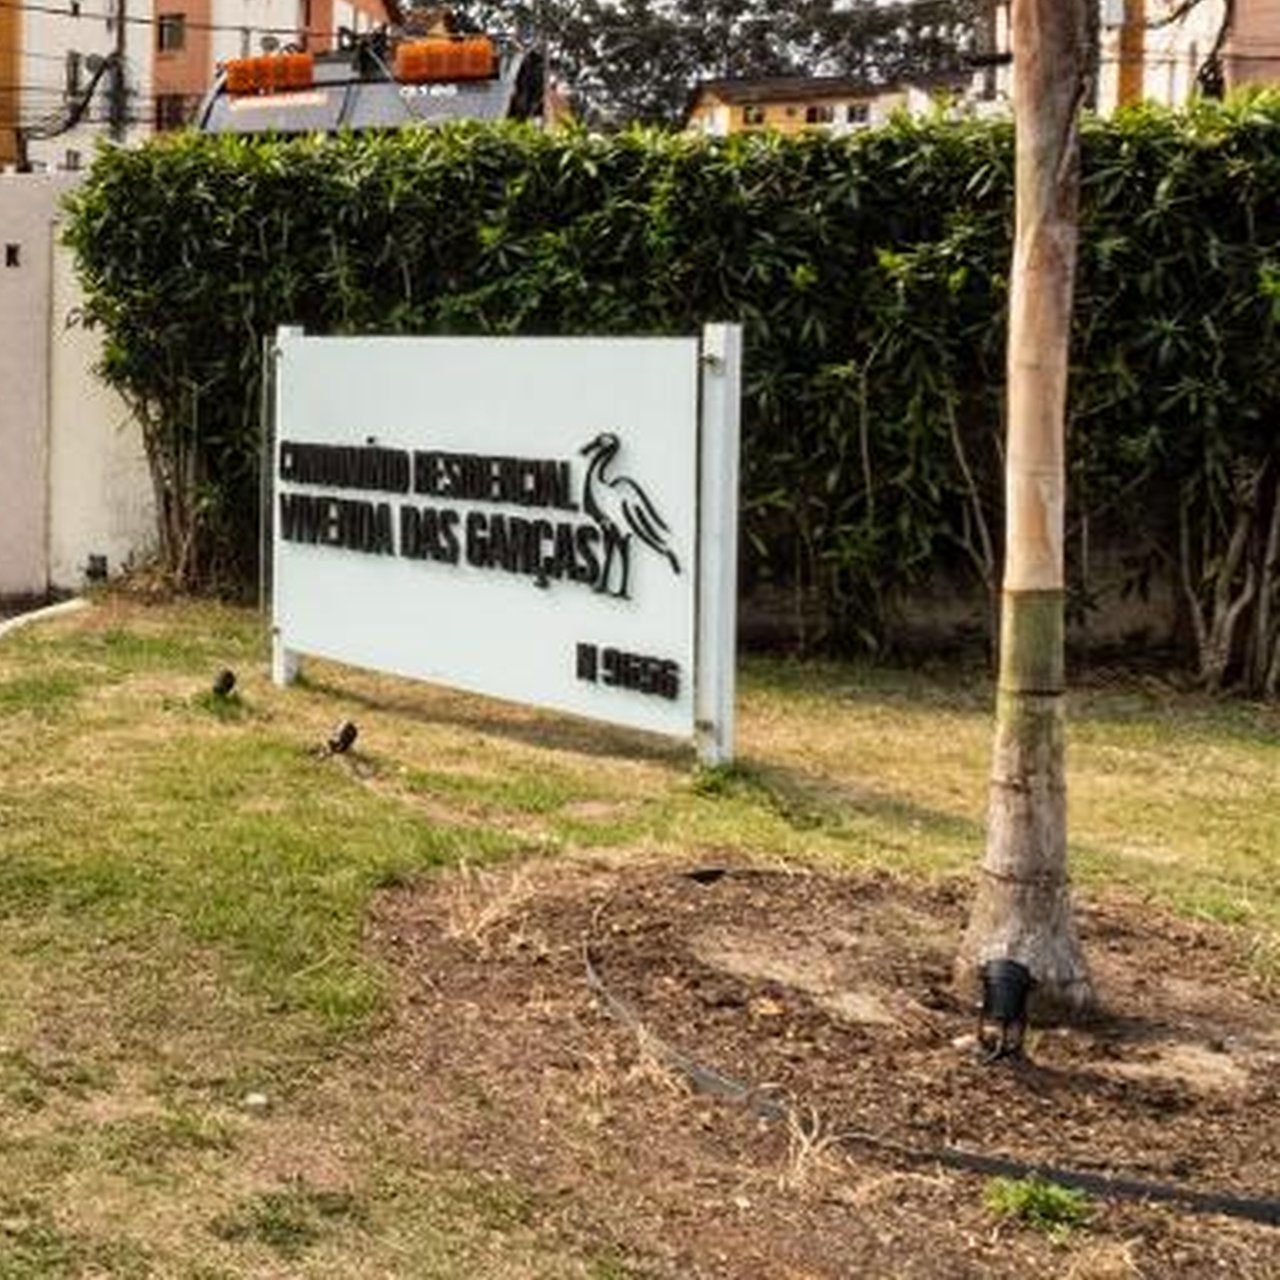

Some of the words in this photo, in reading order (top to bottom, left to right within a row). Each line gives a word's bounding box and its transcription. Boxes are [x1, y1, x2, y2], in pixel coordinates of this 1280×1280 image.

[413, 450, 579, 511] RESIDENCIAL
[279, 493, 395, 556] VIVENDA
[401, 505, 461, 565] DAS
[466, 511, 601, 589] GARÇAS
